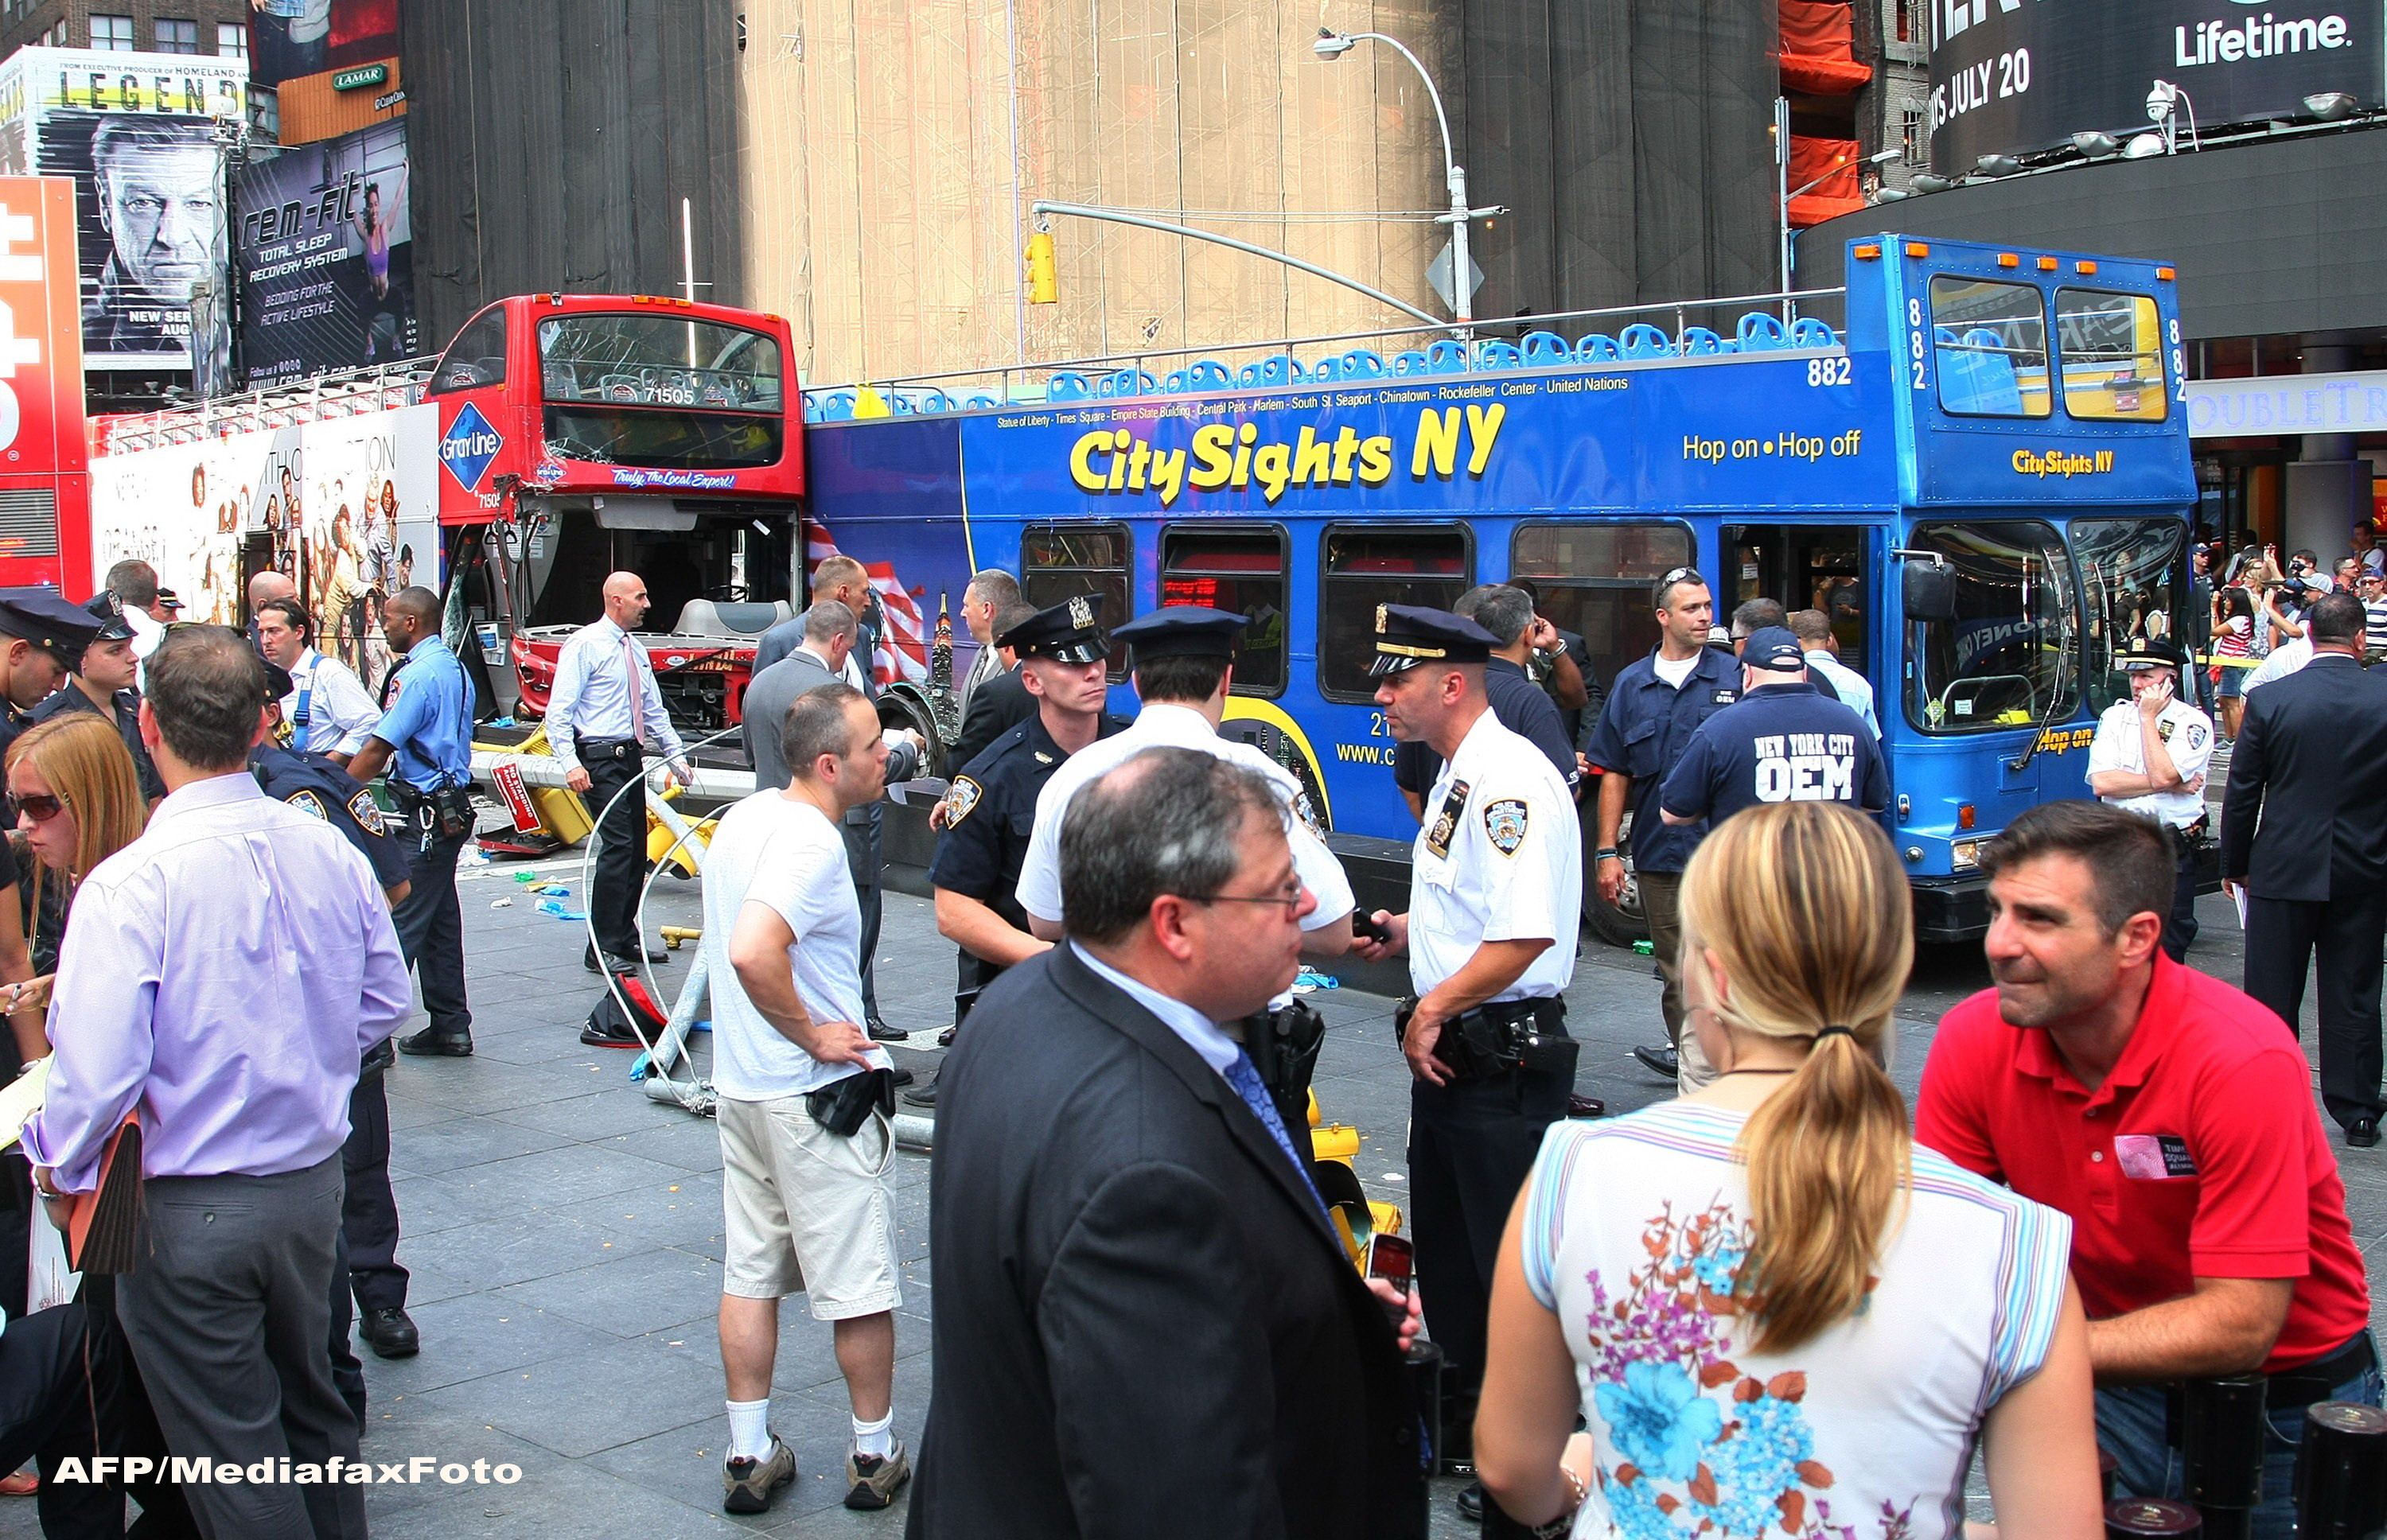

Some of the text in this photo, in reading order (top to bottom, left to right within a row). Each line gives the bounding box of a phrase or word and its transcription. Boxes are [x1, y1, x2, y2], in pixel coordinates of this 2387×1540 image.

[2175, 12, 2353, 68] Lifetime.
[176, 66, 236, 78] HOMELAND
[338, 69, 379, 86] LAMAR
[1949, 58, 1993, 119] JULY
[1999, 48, 2030, 99] 20
[259, 233, 333, 263] TOTAL SLEEP
[249, 247, 349, 283] RECOVERY SYSTEM
[264, 281, 335, 308] BEDDING FOR THE
[129, 310, 161, 323] NEW
[260, 300, 336, 327] ACTIVE LIFESTYLE
[161, 324, 190, 336] AUG
[1807, 357, 1852, 387] 882
[644, 387, 694, 405] 71505
[997, 376, 1629, 429] Statue of Liberty Times Square Empire State Building Central Park Harlem South St. Seaport Chinatown Rockefeller Center United Nations
[1411, 402, 1507, 477] NY
[1683, 430, 1862, 465] Hop on Hop off
[2095, 450, 2113, 473] NY
[611, 469, 736, 490] Truly, The Local Expert!
[1715, 695, 1735, 704] OEM
[1754, 733, 1855, 760] NEW YORK CITY
[2072, 727, 2092, 746] on
[1336, 743, 1396, 766] www.c
[509, 766, 533, 818] NO STANDING
[1754, 755, 1855, 803] OEM
